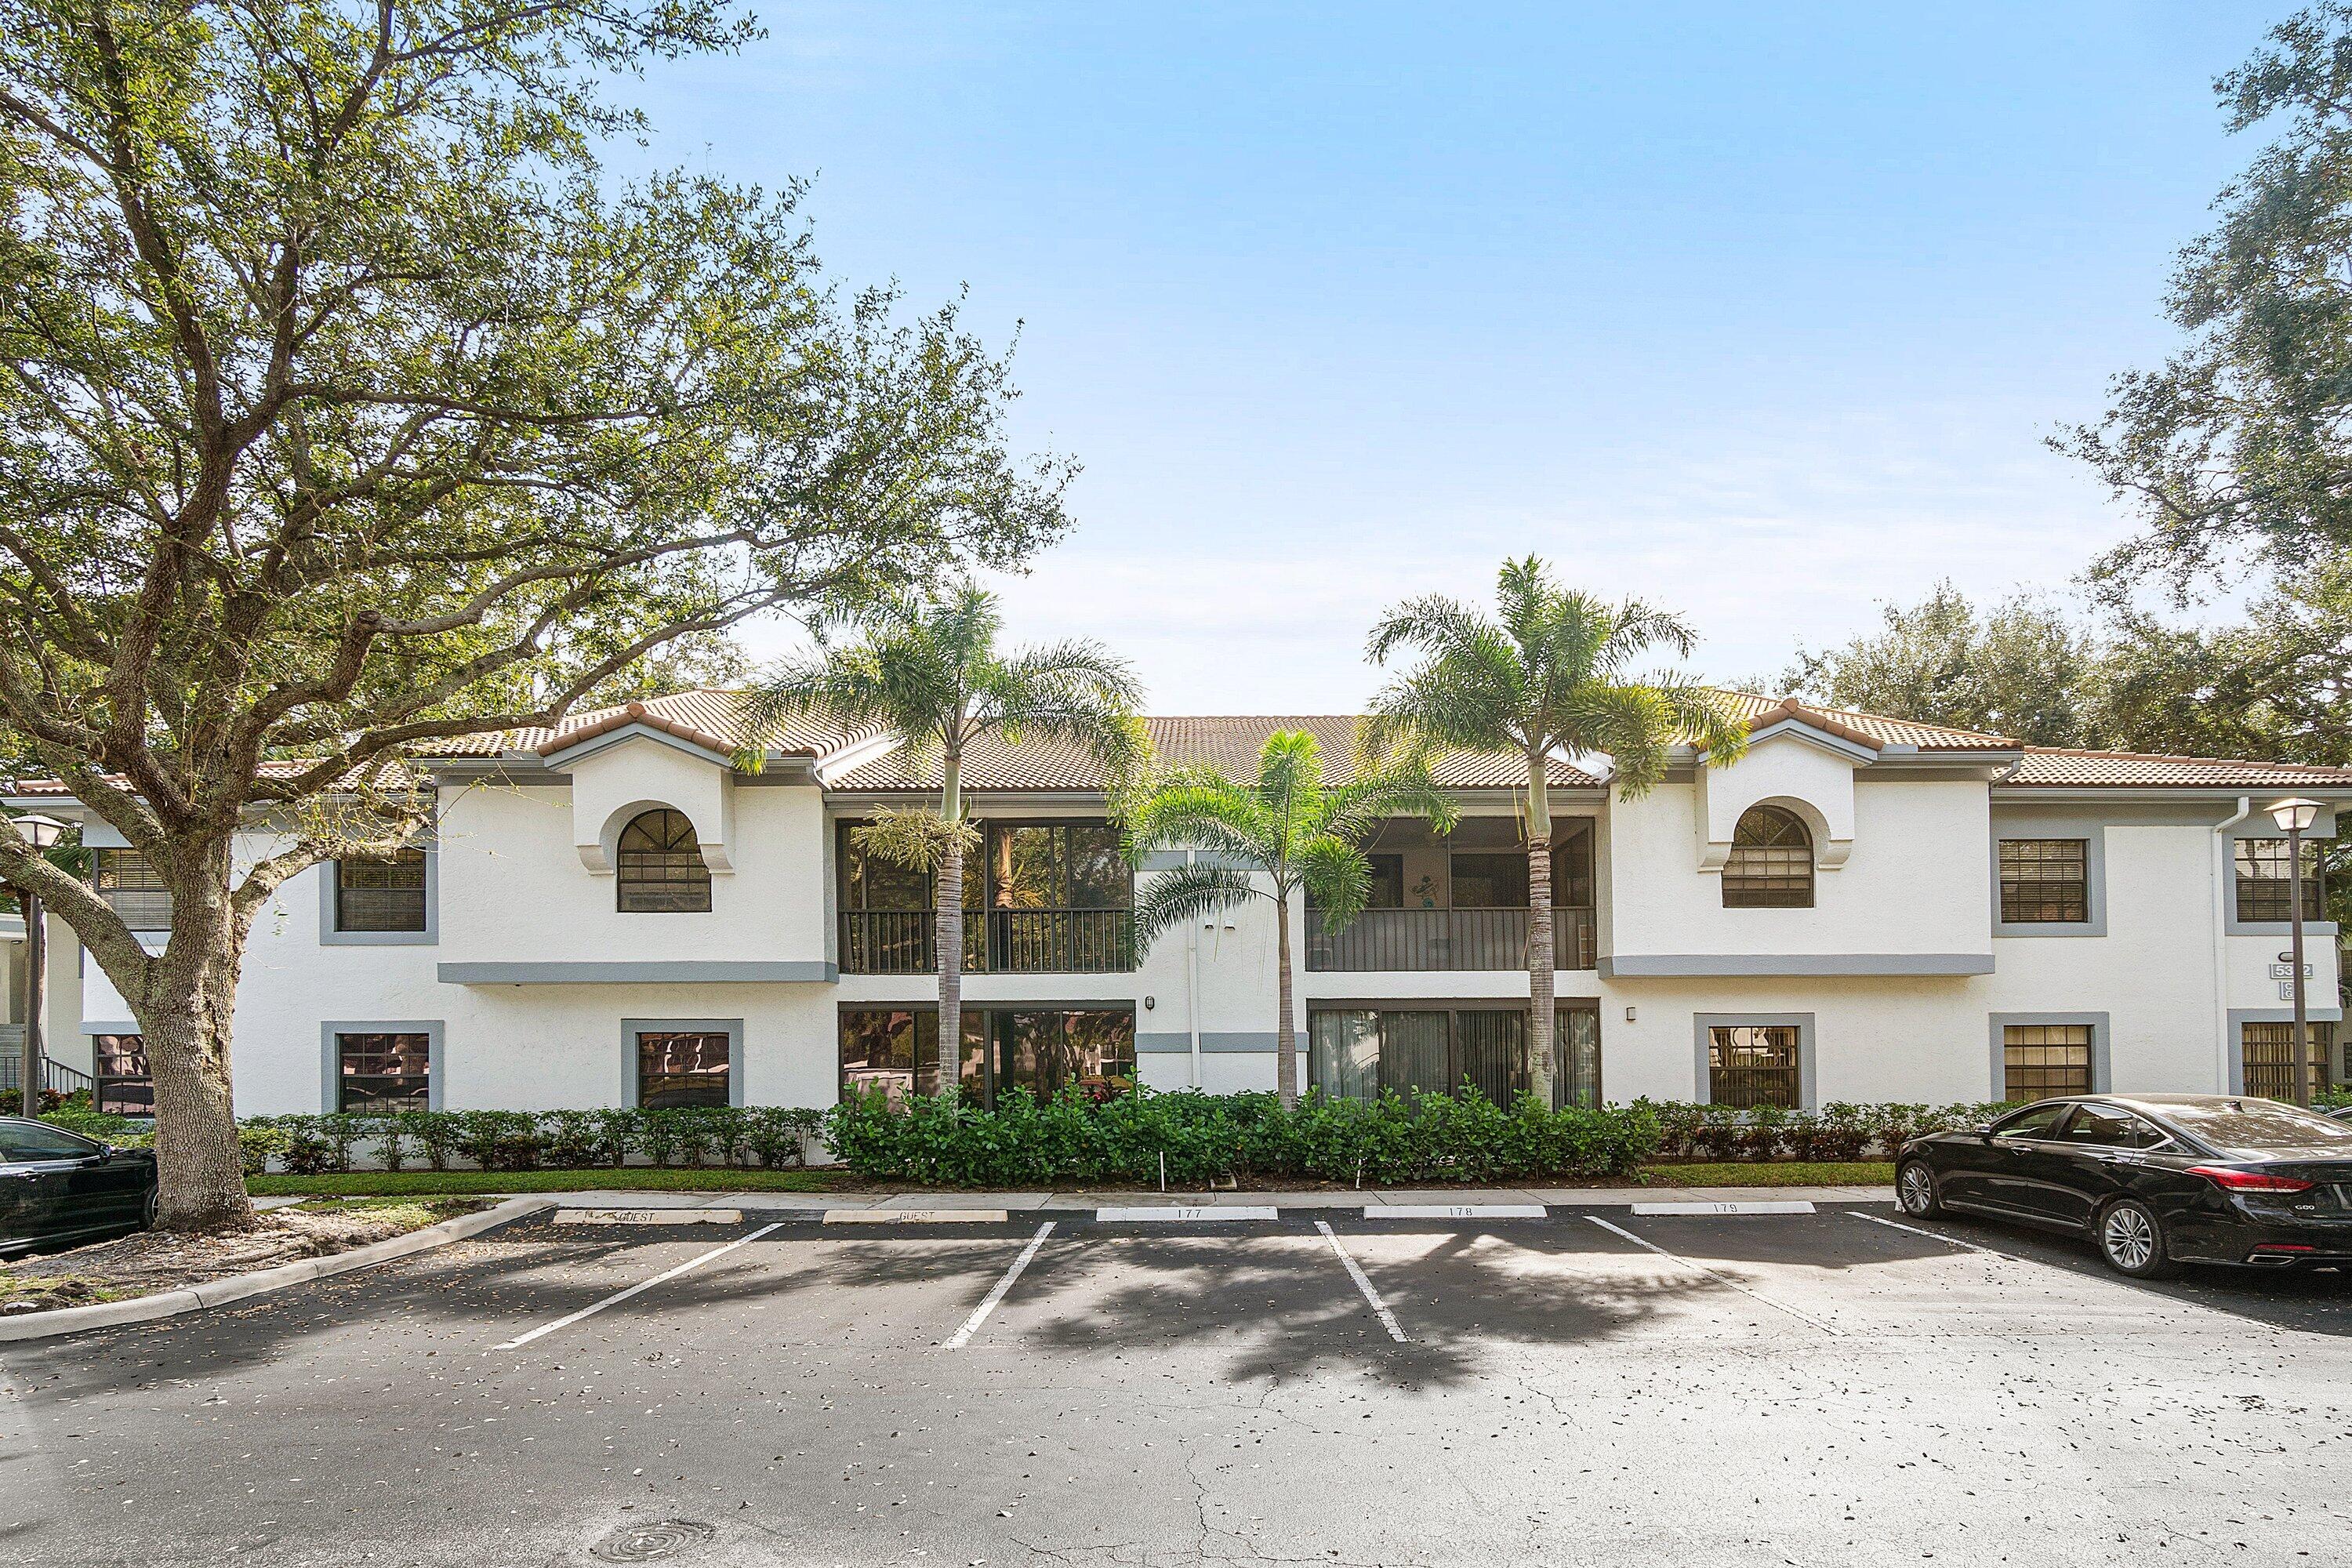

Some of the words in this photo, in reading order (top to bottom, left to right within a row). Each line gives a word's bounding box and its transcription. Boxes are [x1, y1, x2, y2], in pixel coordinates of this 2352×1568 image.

[2276, 965, 2310, 976] 532
[899, 1211, 935, 1221] GUEST
[1450, 1207, 1472, 1216] 178
[619, 1212, 655, 1221] GUEST
